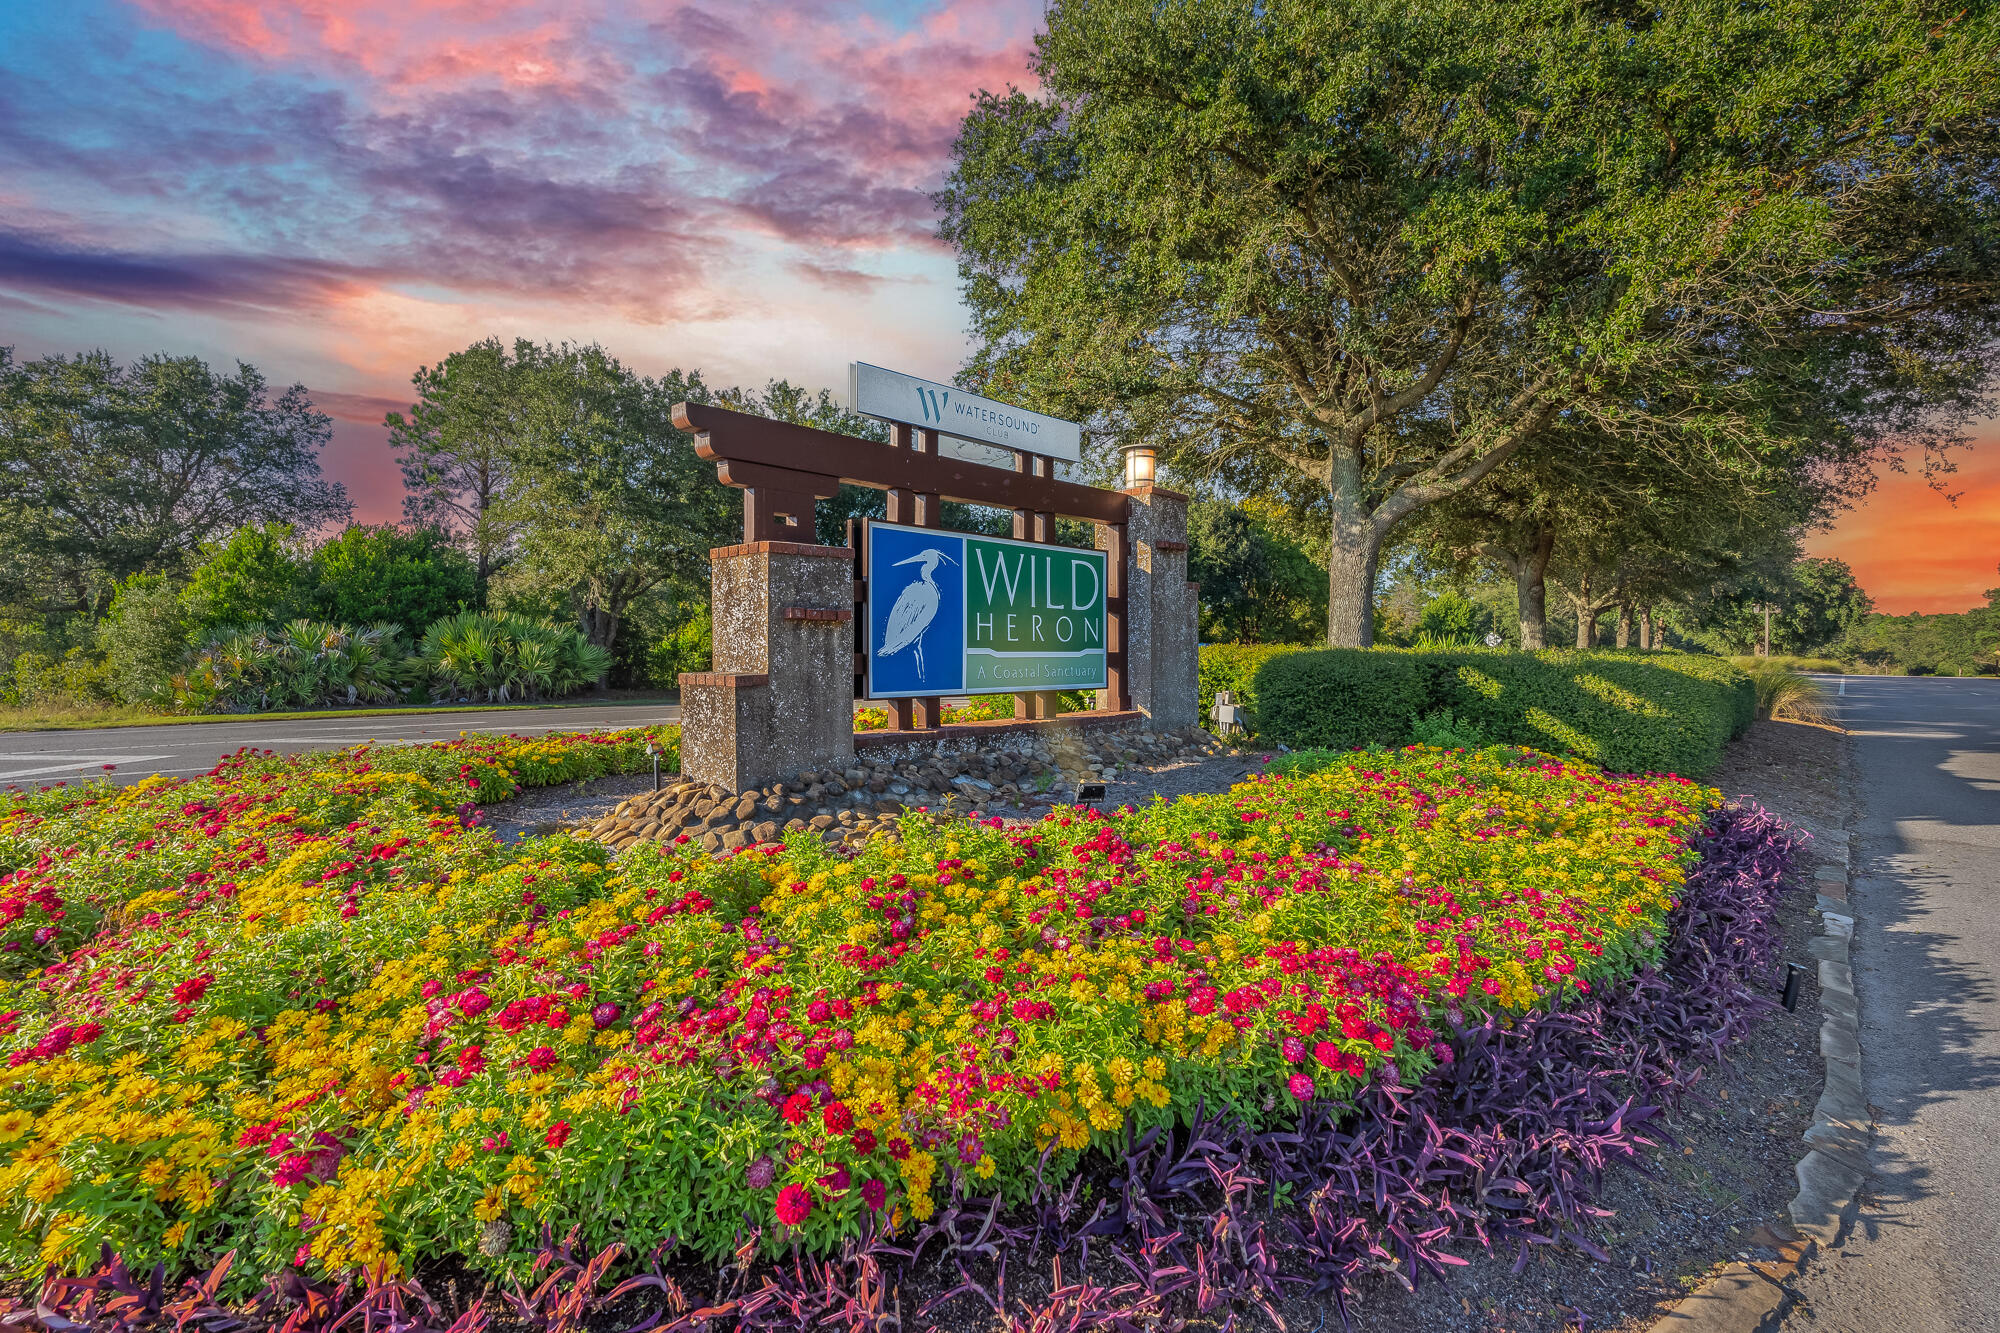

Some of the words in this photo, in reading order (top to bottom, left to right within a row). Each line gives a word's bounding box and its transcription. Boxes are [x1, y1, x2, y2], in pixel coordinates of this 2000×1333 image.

[954, 401, 1038, 435] WATERSOUND
[986, 426, 1009, 439] CLUB
[975, 548, 1099, 611] WILD
[976, 612, 1099, 642] HERON
[977, 664, 986, 679] A
[993, 663, 1041, 679] Coastal
[1044, 664, 1097, 680] Sanctuary
